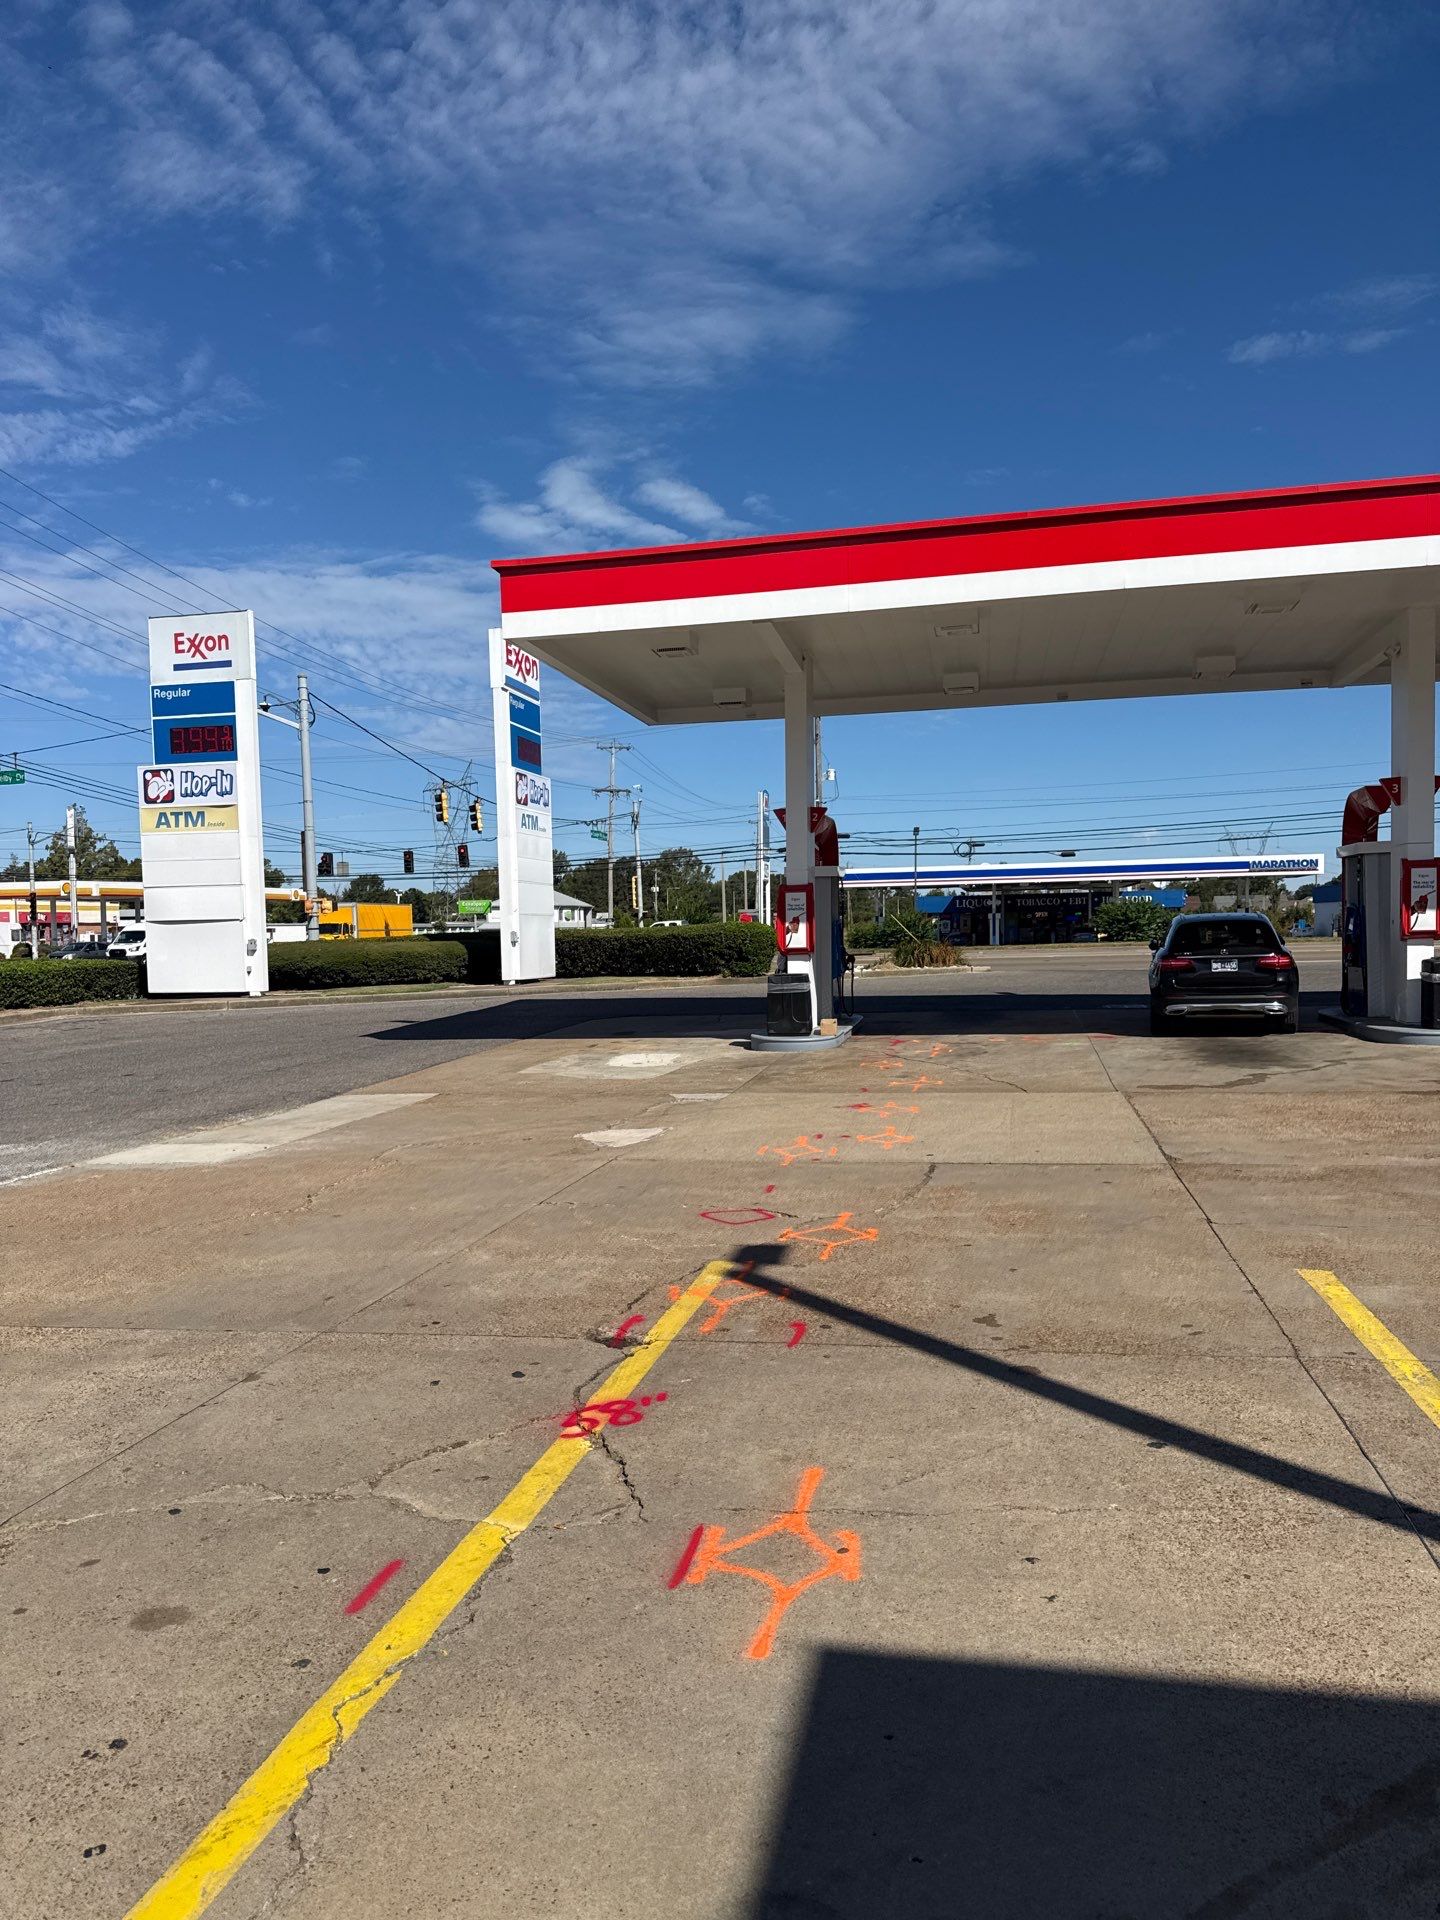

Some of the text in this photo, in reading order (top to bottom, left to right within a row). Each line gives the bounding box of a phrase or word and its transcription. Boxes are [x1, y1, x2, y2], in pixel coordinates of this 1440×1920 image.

[173, 631, 230, 660] Exxon
[505, 639, 539, 682] Exxon
[153, 687, 191, 699] Regular
[1392, 784, 1399, 793] 3
[155, 810, 206, 829] ATM
[521, 813, 538, 831] ATM
[812, 813, 818, 821] 2
[1252, 859, 1319, 868] MARATHON
[1016, 897, 1060, 907] TOBACCO
[1069, 897, 1087, 905] EBT
